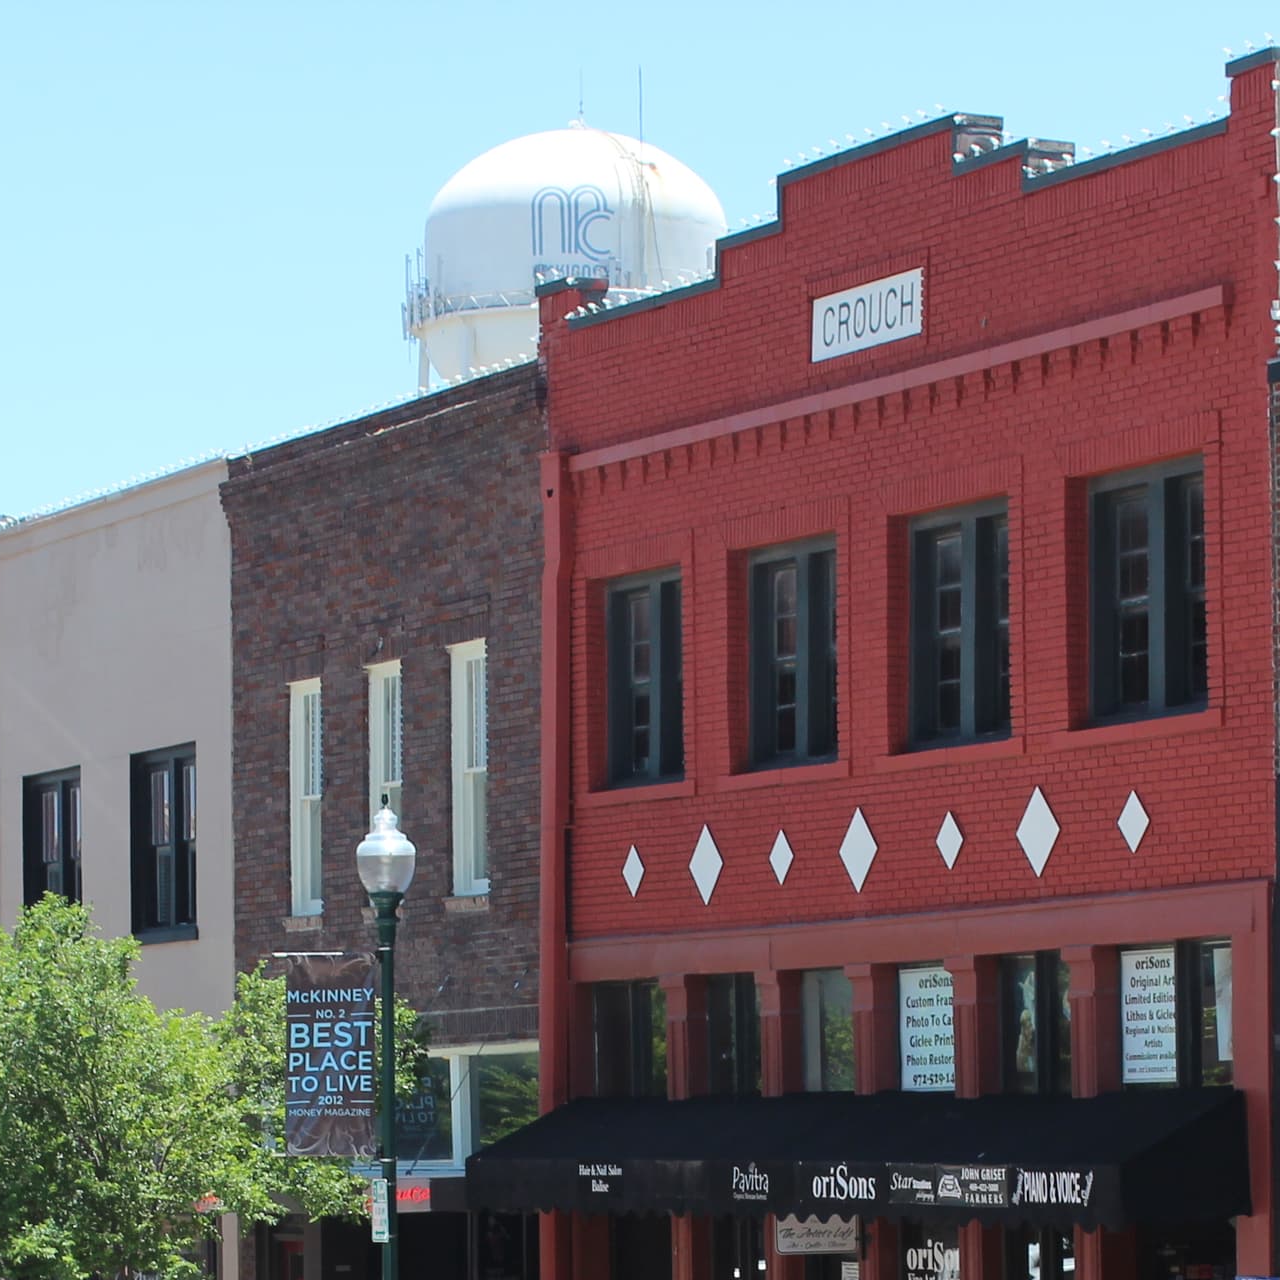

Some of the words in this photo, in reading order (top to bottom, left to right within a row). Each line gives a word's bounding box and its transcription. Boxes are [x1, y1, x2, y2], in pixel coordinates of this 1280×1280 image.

[823, 282, 914, 347] CROUCH
[1135, 956, 1170, 970] oriSons
[1130, 976, 1160, 991] Original
[287, 988, 374, 1003] McKINNEY
[906, 996, 934, 1008] Custom
[1125, 994, 1151, 1005] Limited
[315, 1009, 336, 1019] NO.
[339, 1008, 346, 1019] 2
[906, 1016, 929, 1028] Photo
[931, 1014, 940, 1026] To
[290, 1021, 372, 1048] BEST
[288, 1051, 372, 1072] PLACE
[906, 1055, 927, 1066] Photo
[288, 1076, 318, 1093] TO
[326, 1075, 372, 1092] LIVE
[318, 1095, 344, 1106] 2012
[289, 1109, 322, 1117] MONEY
[324, 1108, 371, 1116] MAGAZINE
[732, 1165, 769, 1193] Pavitra
[961, 1168, 979, 1181] JOHN
[981, 1168, 1006, 1181] GRISET
[812, 1165, 876, 1200] oriSons
[1024, 1171, 1048, 1203] PIANO
[1050, 1173, 1056, 1203] &
[1056, 1172, 1081, 1203] VOICE
[965, 1194, 1004, 1204] FARMERS
